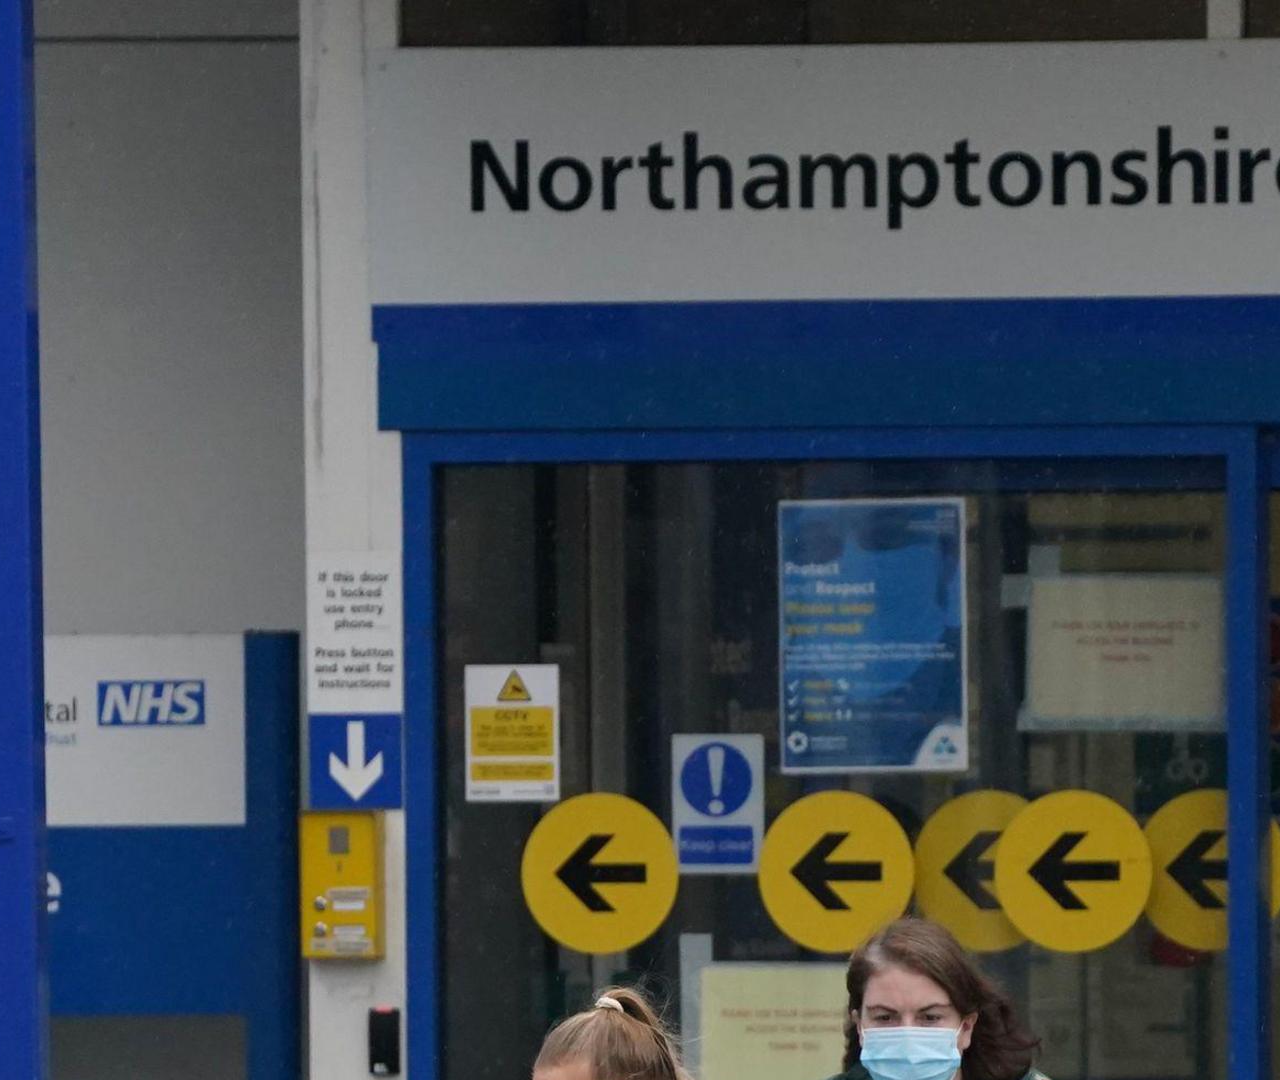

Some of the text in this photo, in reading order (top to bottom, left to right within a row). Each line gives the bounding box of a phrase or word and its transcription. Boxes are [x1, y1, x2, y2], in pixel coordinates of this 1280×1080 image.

[318, 570, 388, 582] If this door
[326, 586, 382, 598] is locked
[324, 604, 383, 616] use entry
[334, 619, 374, 631] phone
[315, 646, 394, 658] Press button
[315, 662, 394, 673] and wait for
[318, 678, 391, 689] instructions
[100, 681, 202, 723] NHS
